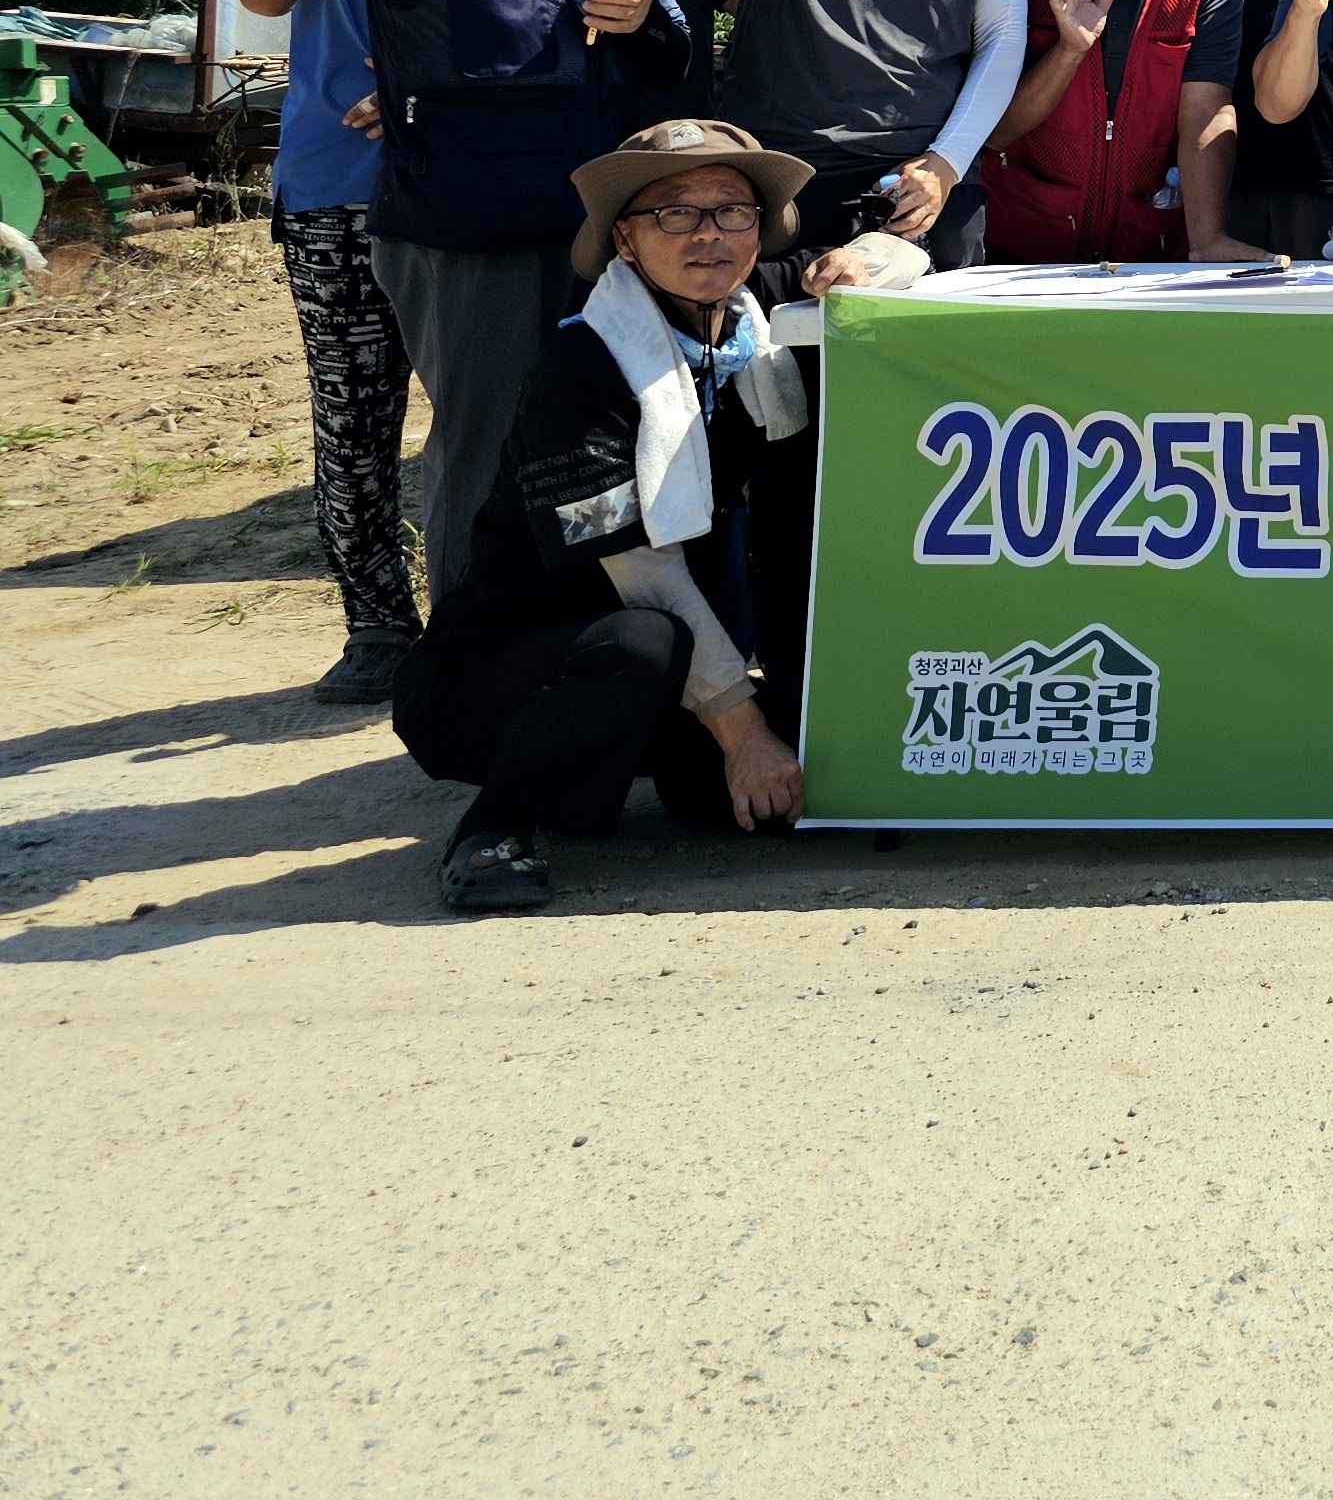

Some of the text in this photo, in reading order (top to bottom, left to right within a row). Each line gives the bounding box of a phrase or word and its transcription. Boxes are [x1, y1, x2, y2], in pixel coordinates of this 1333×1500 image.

[917, 408, 1328, 574] 2025년
[914, 657, 984, 676] 청정괴산
[909, 680, 1154, 743] 자연울림
[907, 750, 1148, 768] 자연이 미래가 되는 그 곳
